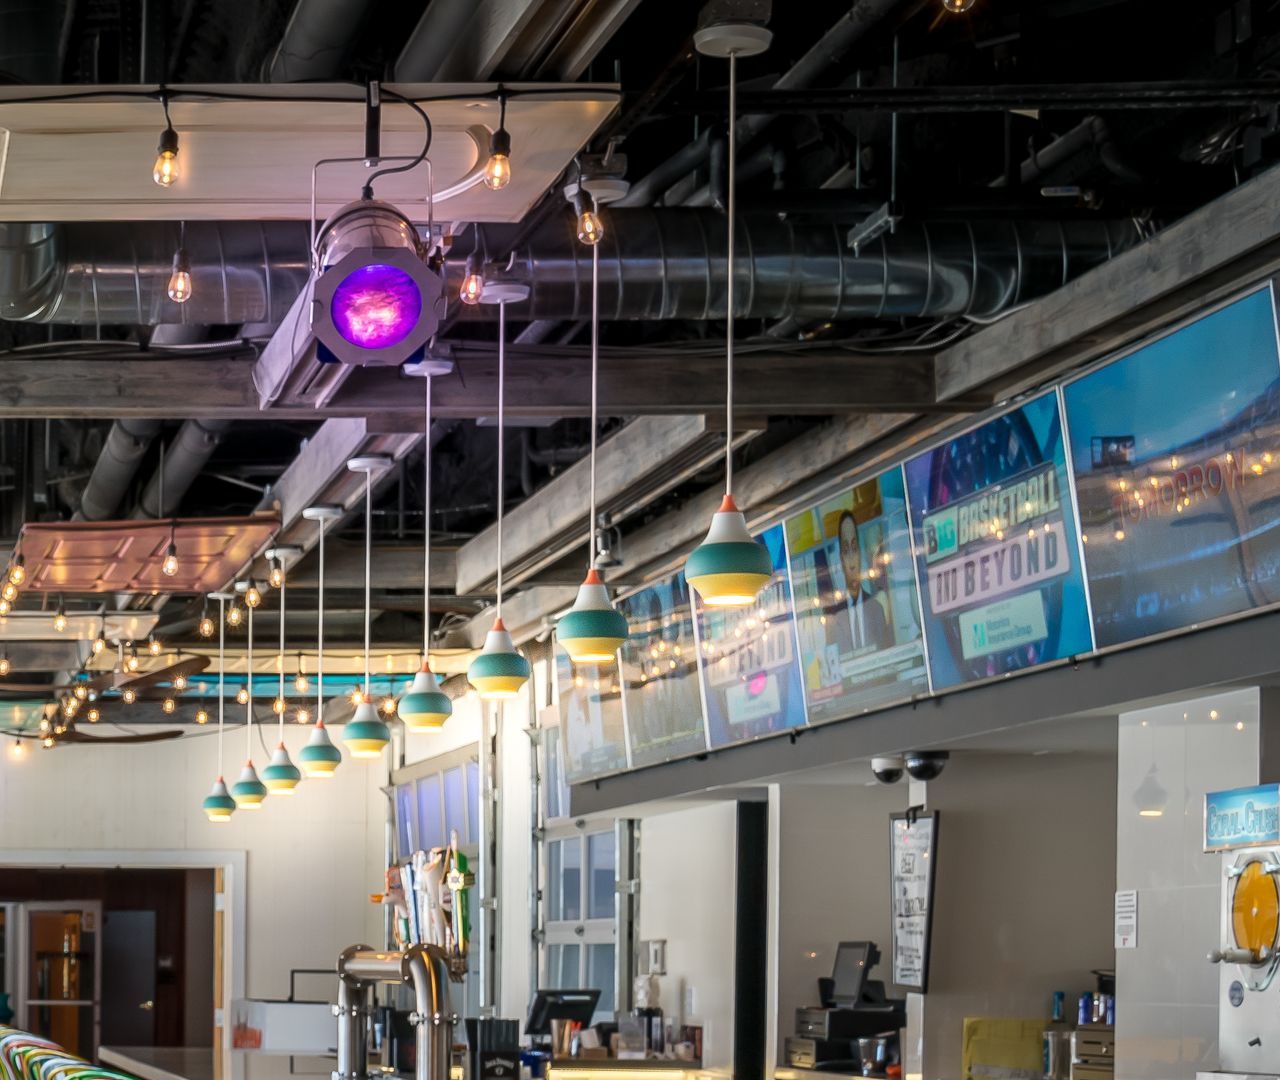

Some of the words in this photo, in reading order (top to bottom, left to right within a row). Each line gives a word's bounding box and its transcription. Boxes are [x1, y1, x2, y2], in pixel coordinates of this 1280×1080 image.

[958, 469, 1060, 545] BASKETBALL
[936, 568, 957, 606] AND
[964, 531, 1058, 597] BEYOND
